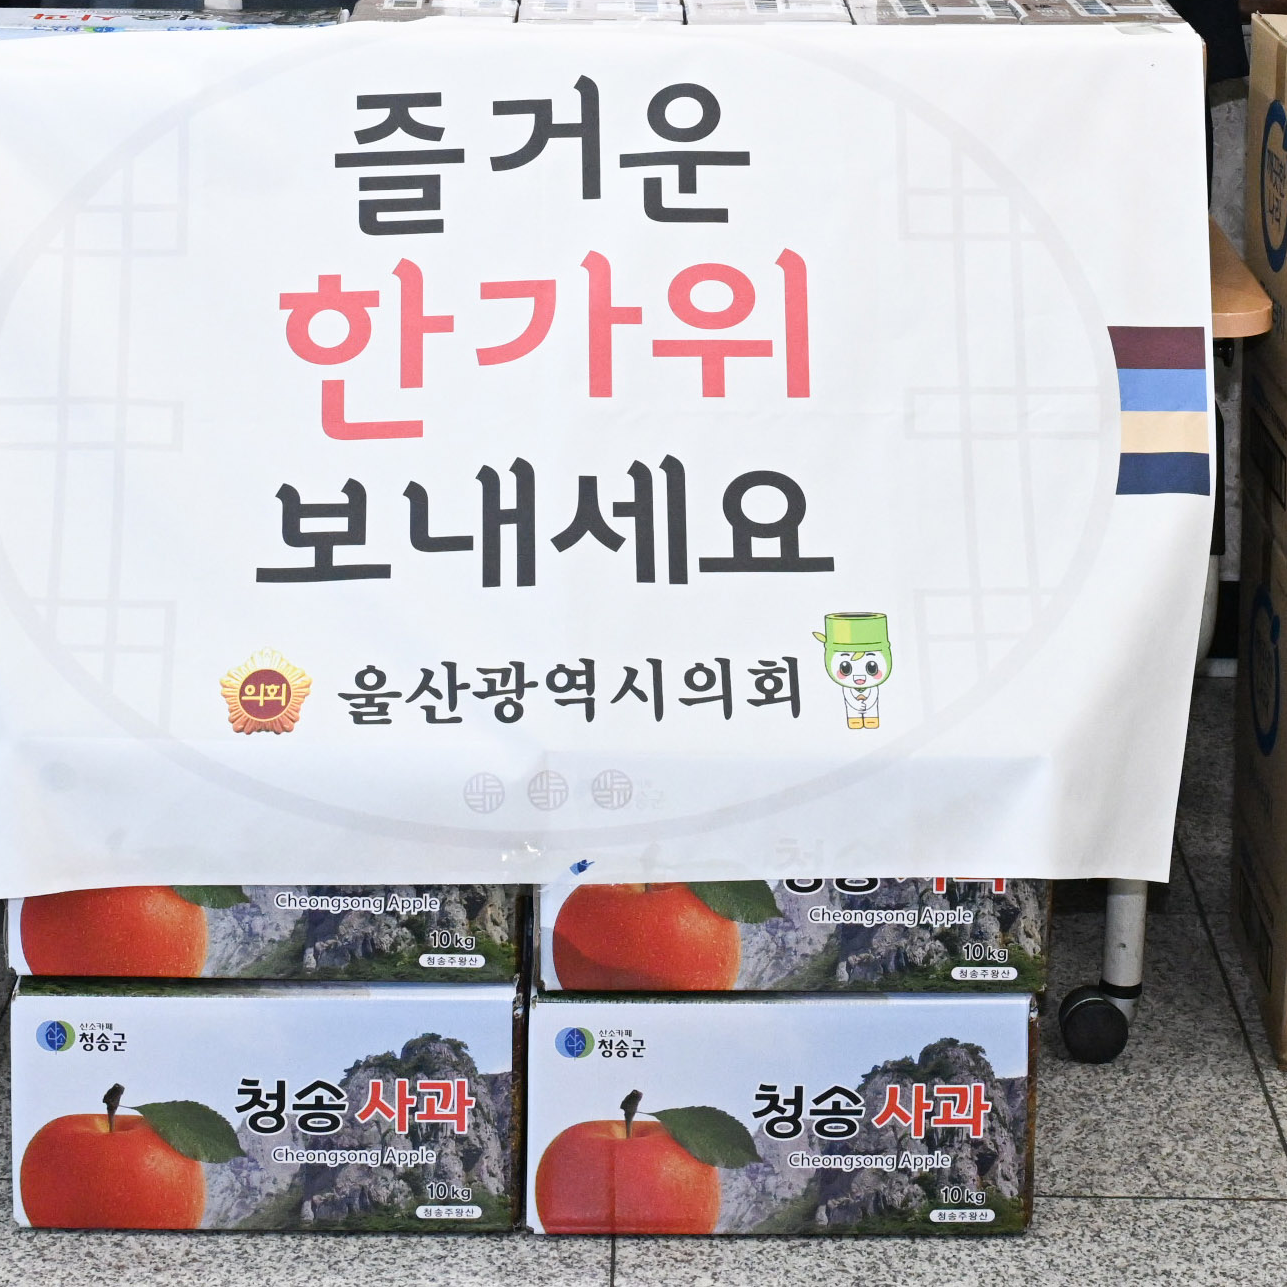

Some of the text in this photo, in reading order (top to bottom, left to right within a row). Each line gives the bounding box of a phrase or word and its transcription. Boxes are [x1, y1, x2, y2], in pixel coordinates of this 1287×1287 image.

[335, 75, 751, 236] 즐거운
[279, 248, 811, 441] 한가위
[256, 454, 835, 588] 보내세요
[239, 679, 287, 707] 의회
[338, 656, 802, 725] 울산광역시의회
[274, 893, 440, 913] Cheongsong Apple
[809, 907, 973, 927] Cheongsong Apple
[79, 1031, 127, 1053] 청송군
[597, 1038, 646, 1059] 청송군
[235, 1077, 475, 1134] 청송 사과
[752, 1083, 992, 1139] 청송 사과
[272, 1147, 436, 1167] Cheongsong Apple
[789, 1151, 951, 1172] Cheongsong Apple
[423, 1207, 475, 1218] 청송주왕산
[936, 1211, 989, 1222] 청송주왕산
